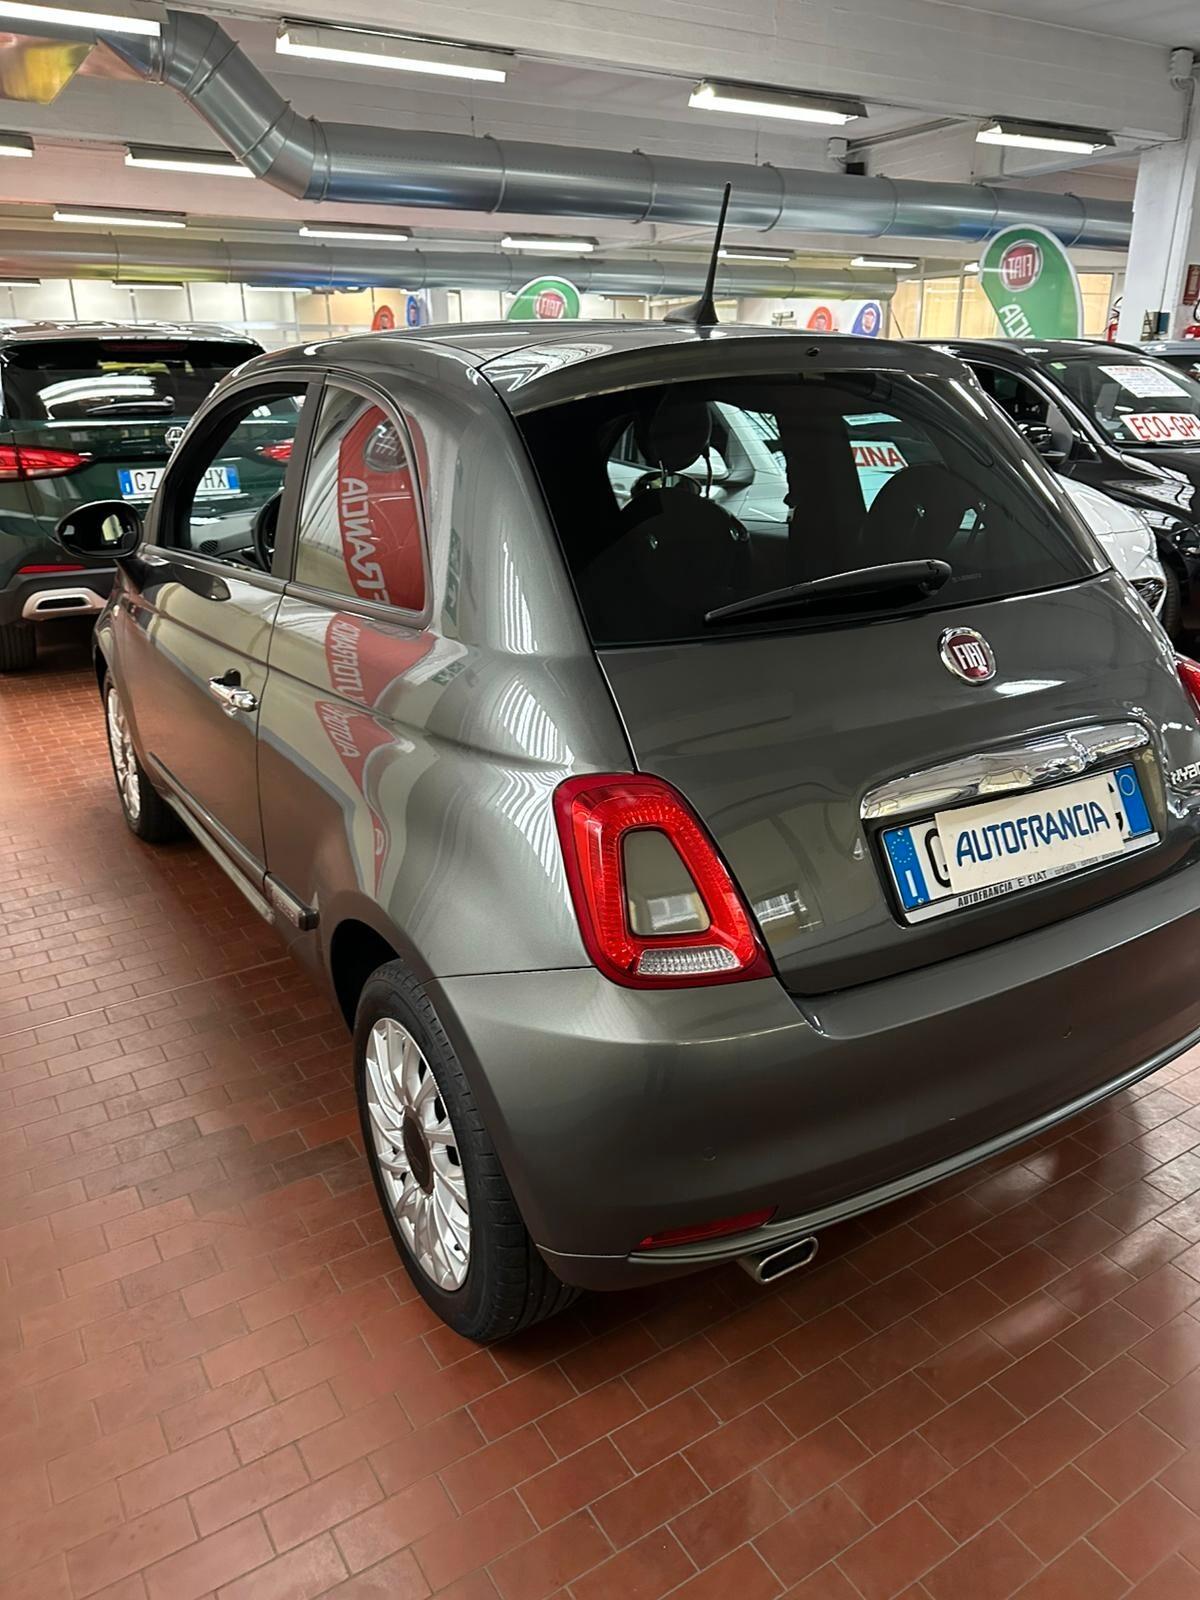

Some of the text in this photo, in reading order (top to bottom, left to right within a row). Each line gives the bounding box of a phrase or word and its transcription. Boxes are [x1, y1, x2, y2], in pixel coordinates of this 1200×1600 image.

[134, 471, 158, 491] GZ
[203, 469, 227, 489] HX
[952, 642, 987, 670] FIAT
[956, 801, 1111, 867] AUTOFRANCIA
[958, 881, 1013, 907] AUTOFRANCIA
[1028, 871, 1048, 884] FIAT
